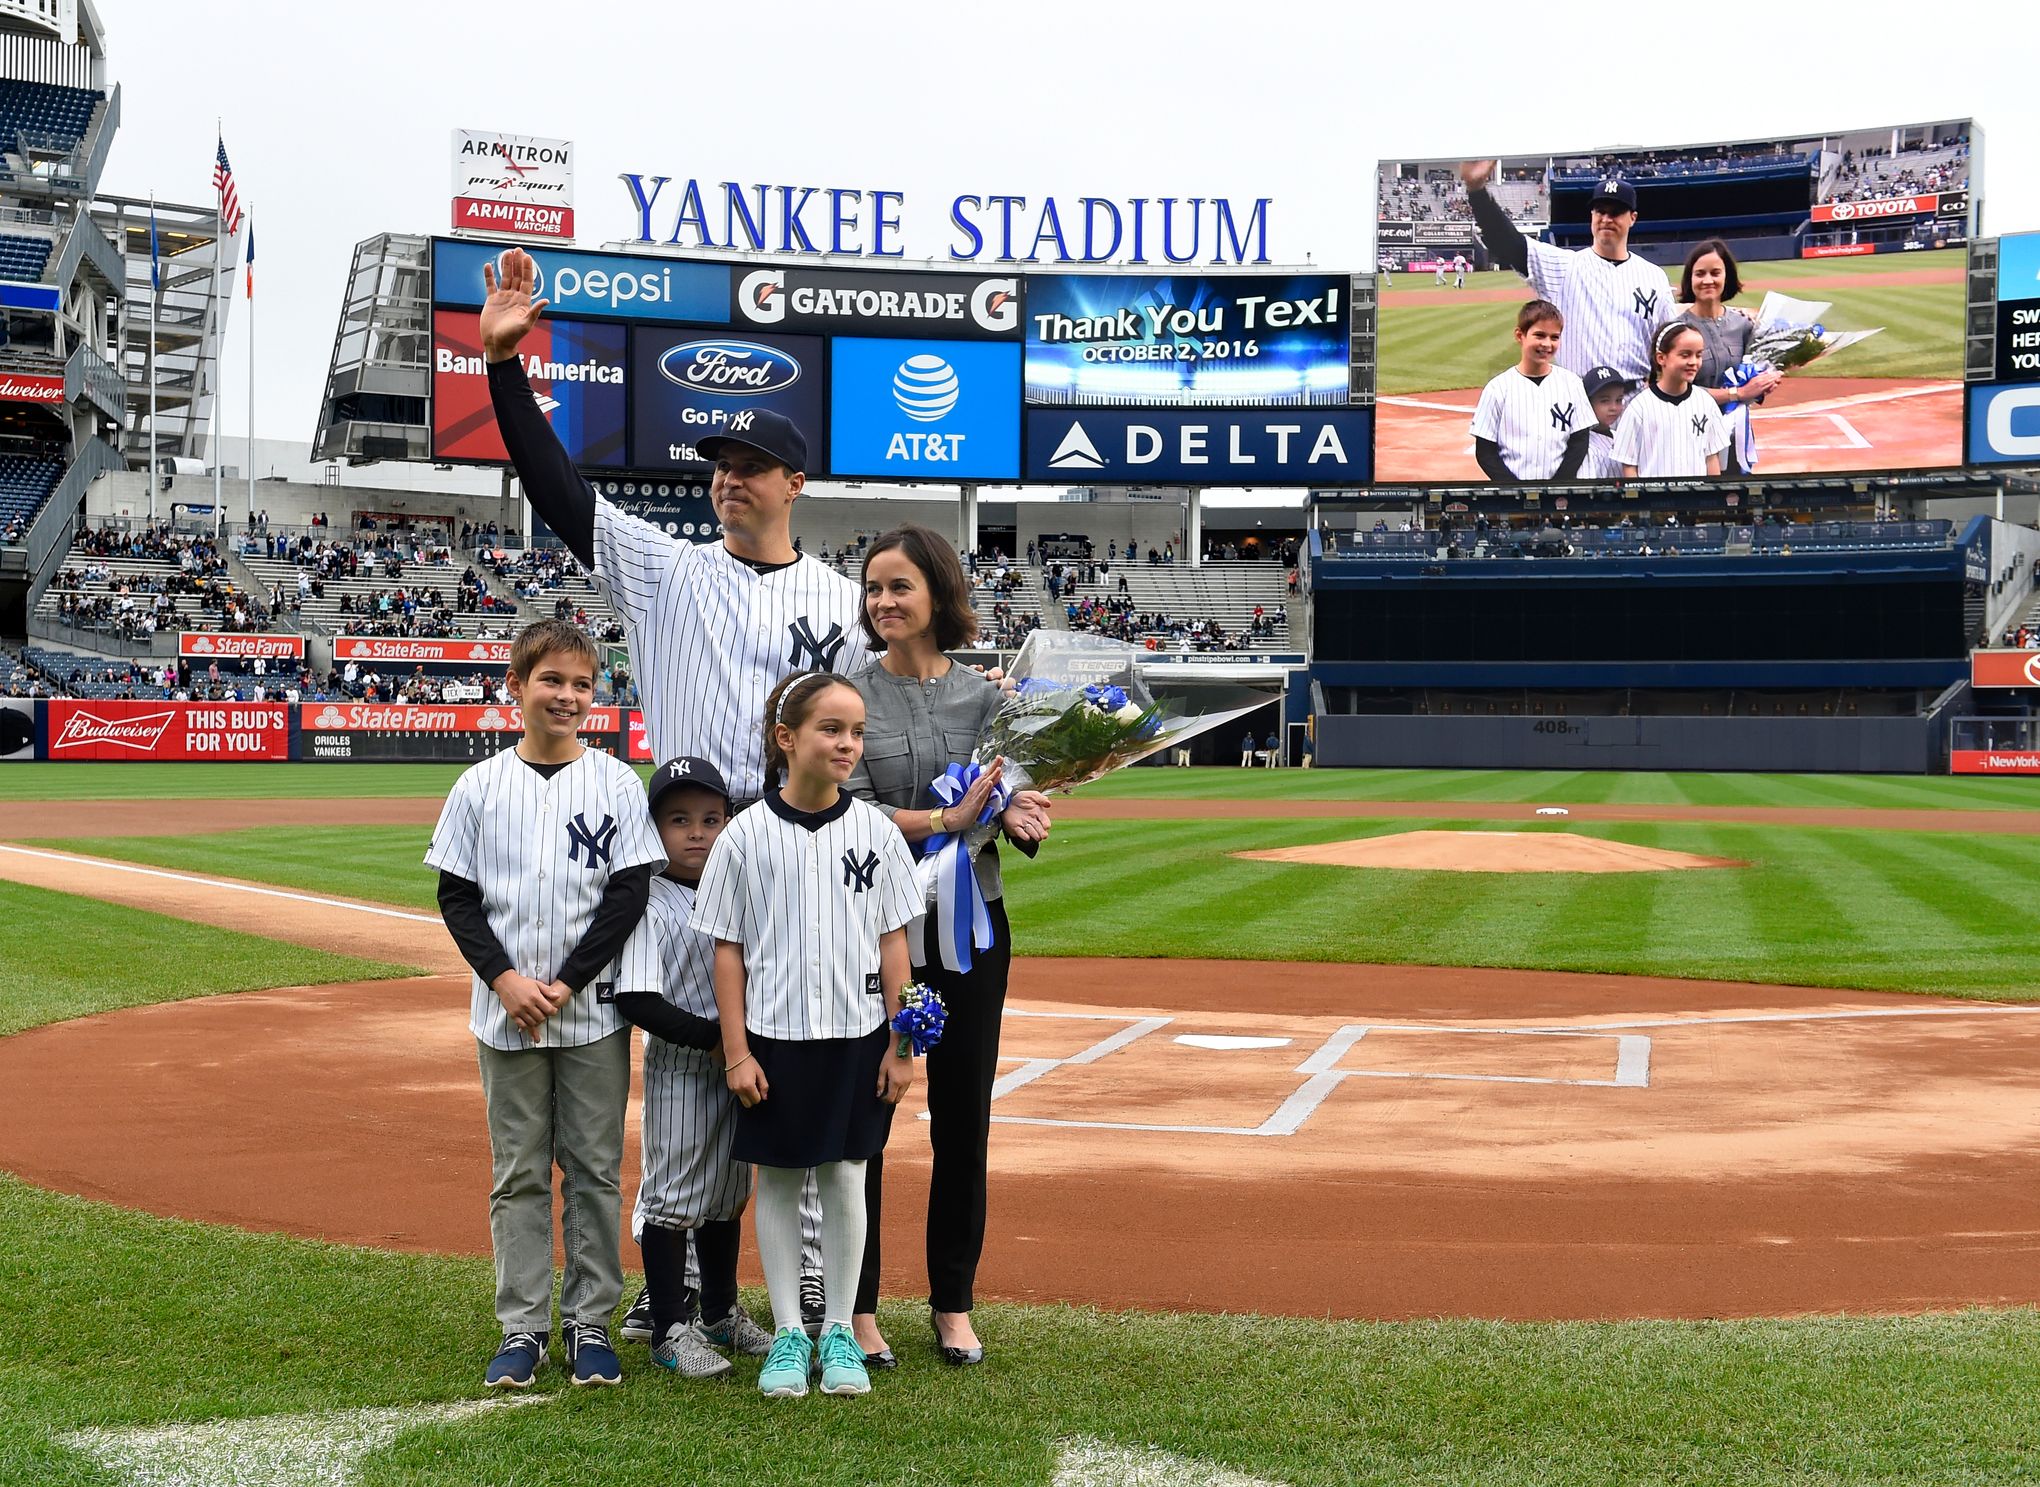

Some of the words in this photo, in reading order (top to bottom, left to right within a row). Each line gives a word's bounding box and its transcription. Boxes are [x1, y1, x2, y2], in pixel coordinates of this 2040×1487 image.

[461, 140, 568, 165] ARMITRON
[466, 202, 563, 224] ARMITRON
[1856, 199, 1918, 216] TOYOTA
[514, 220, 561, 233] WATCHES
[617, 173, 905, 258] YANKEE
[948, 194, 1273, 264] STADIUM
[554, 267, 672, 307] pepsi
[738, 270, 786, 323] G
[792, 287, 965, 319] GATORADE
[970, 278, 1019, 331] G
[1035, 308, 1137, 342] Thank
[1145, 304, 1223, 335] You
[1236, 288, 1339, 329] Tex!
[1082, 345, 1174, 363] OCTOBER
[1178, 344, 1197, 362] 2,
[1203, 339, 1259, 359] 2016
[526, 355, 624, 384] America
[687, 347, 772, 386] Ford
[0, 379, 62, 398] dweiser
[682, 408, 708, 424] Go
[886, 433, 966, 462] AT&T
[1126, 424, 1348, 465] DELTA
[641, 500, 681, 517] Yankees
[1187, 655, 1251, 664] pinstripebowl.com
[447, 689, 458, 697] TEX
[65, 719, 163, 739] Budweiser
[186, 710, 227, 729] THIS
[231, 710, 284, 730] BUD'S
[186, 733, 220, 751] FOR
[225, 733, 266, 752] YOU.
[315, 735, 350, 746] ORIOLES
[314, 746, 351, 757] YANKEES
